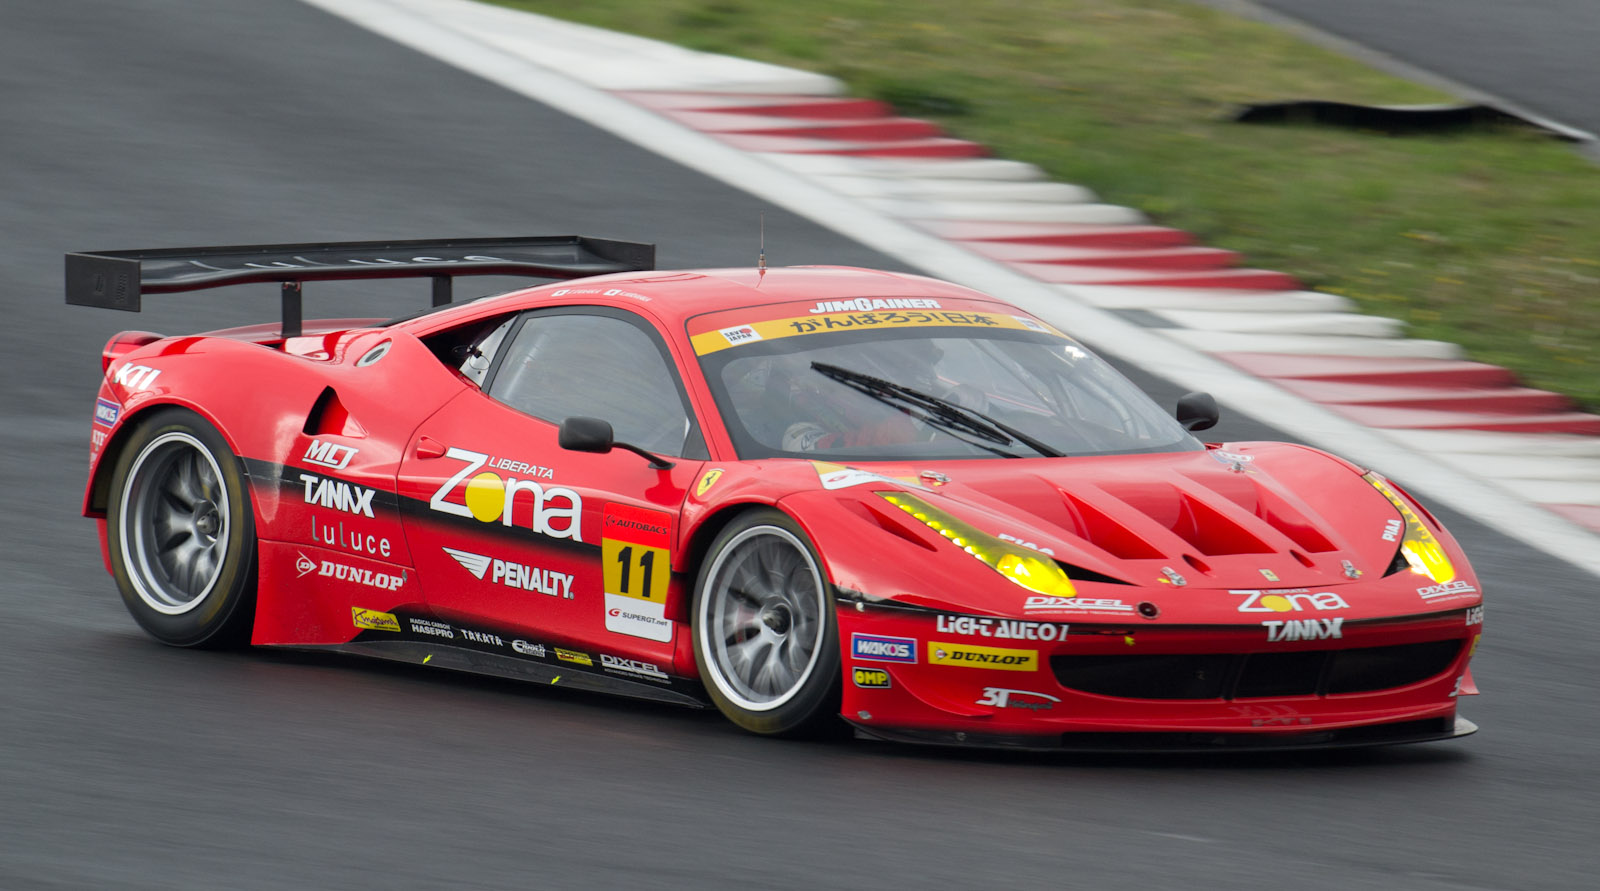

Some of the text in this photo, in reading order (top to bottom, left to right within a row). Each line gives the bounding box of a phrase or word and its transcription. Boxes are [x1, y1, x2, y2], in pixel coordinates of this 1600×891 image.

[809, 297, 941, 314] JIMGAINER
[790, 312, 999, 334] がんばろう!日本
[728, 333, 752, 343] JAPAN
[113, 362, 162, 390] KTI
[488, 455, 554, 480] LIBERATA
[300, 474, 376, 519] TANAX
[430, 447, 583, 542] Zona
[312, 515, 391, 557] luluce
[616, 519, 667, 535] AUTOBACS
[1381, 519, 1402, 542] PIAA
[998, 533, 1055, 556] PIAA
[318, 560, 405, 591] DUNLOP
[492, 558, 575, 600] PENALTY
[617, 546, 654, 598] 11
[1416, 580, 1475, 597] DIXCEL
[1025, 596, 1133, 609] DIXCEL
[1228, 589, 1351, 613] Zona
[622, 611, 668, 626] SUPERGT.net
[1261, 616, 1344, 642] TANAX
[411, 623, 454, 639] HASEPRO
[461, 629, 503, 647] TAKATA
[857, 640, 910, 658] WAKOS
[950, 650, 1030, 665] DUNLOP
[600, 653, 667, 677] DIXCEL
[855, 670, 888, 685] OMP
